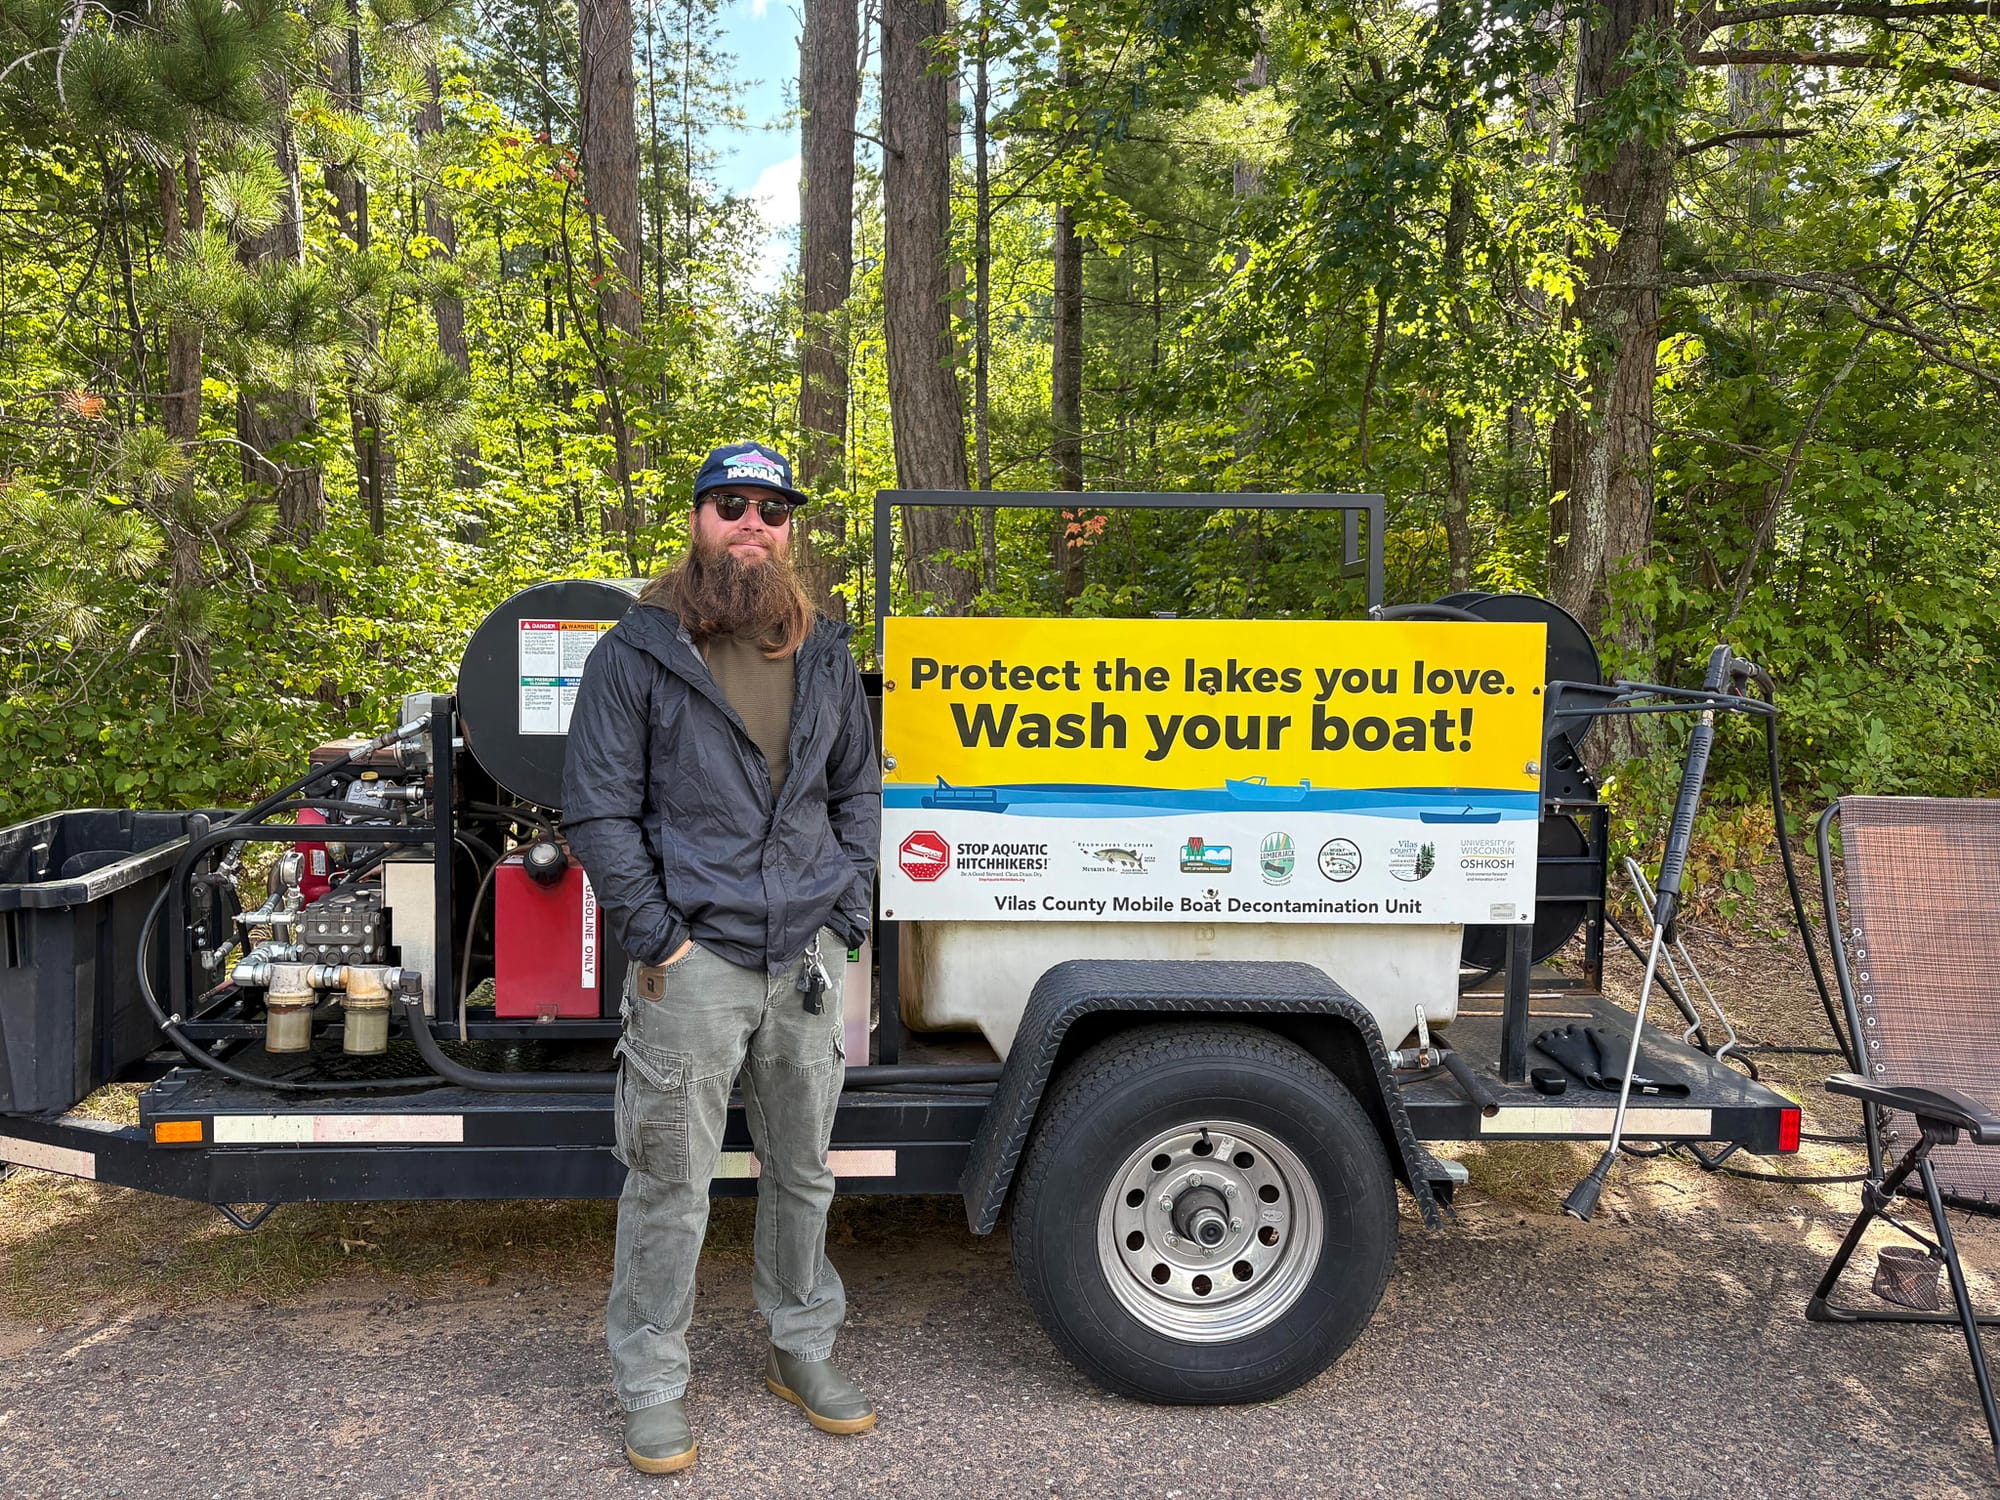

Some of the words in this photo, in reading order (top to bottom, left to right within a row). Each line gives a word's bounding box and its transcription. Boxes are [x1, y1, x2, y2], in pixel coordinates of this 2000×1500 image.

[911, 657, 1081, 691] Protect
[1093, 657, 1170, 692] the
[1184, 658, 1303, 693] lakes
[1313, 668, 1398, 702] you
[1413, 660, 1515, 695] love.
[949, 701, 1127, 749] Wash
[1144, 713, 1292, 761] your
[1311, 703, 1474, 752] boat!
[1398, 840, 1418, 848] Vilas
[1460, 839, 1507, 847] UNIVERSITY
[957, 843, 990, 855] STOP
[992, 843, 1048, 857] AQUATIC
[1260, 850, 1295, 860] LUMBERJACK
[1460, 847, 1515, 855] WISCONSIN
[956, 857, 1048, 870] HITCHHIKERS!
[1460, 859, 1515, 869] OSHKOSH
[585, 884, 595, 939] GASOLINE
[994, 896, 1037, 912] Vilas
[1042, 896, 1106, 915] County
[1113, 896, 1174, 912] Mobile
[1180, 897, 1222, 913] Boat
[1227, 897, 1379, 914] Decontamination
[1385, 898, 1422, 914] Unit
[584, 946, 594, 974] ONLY
